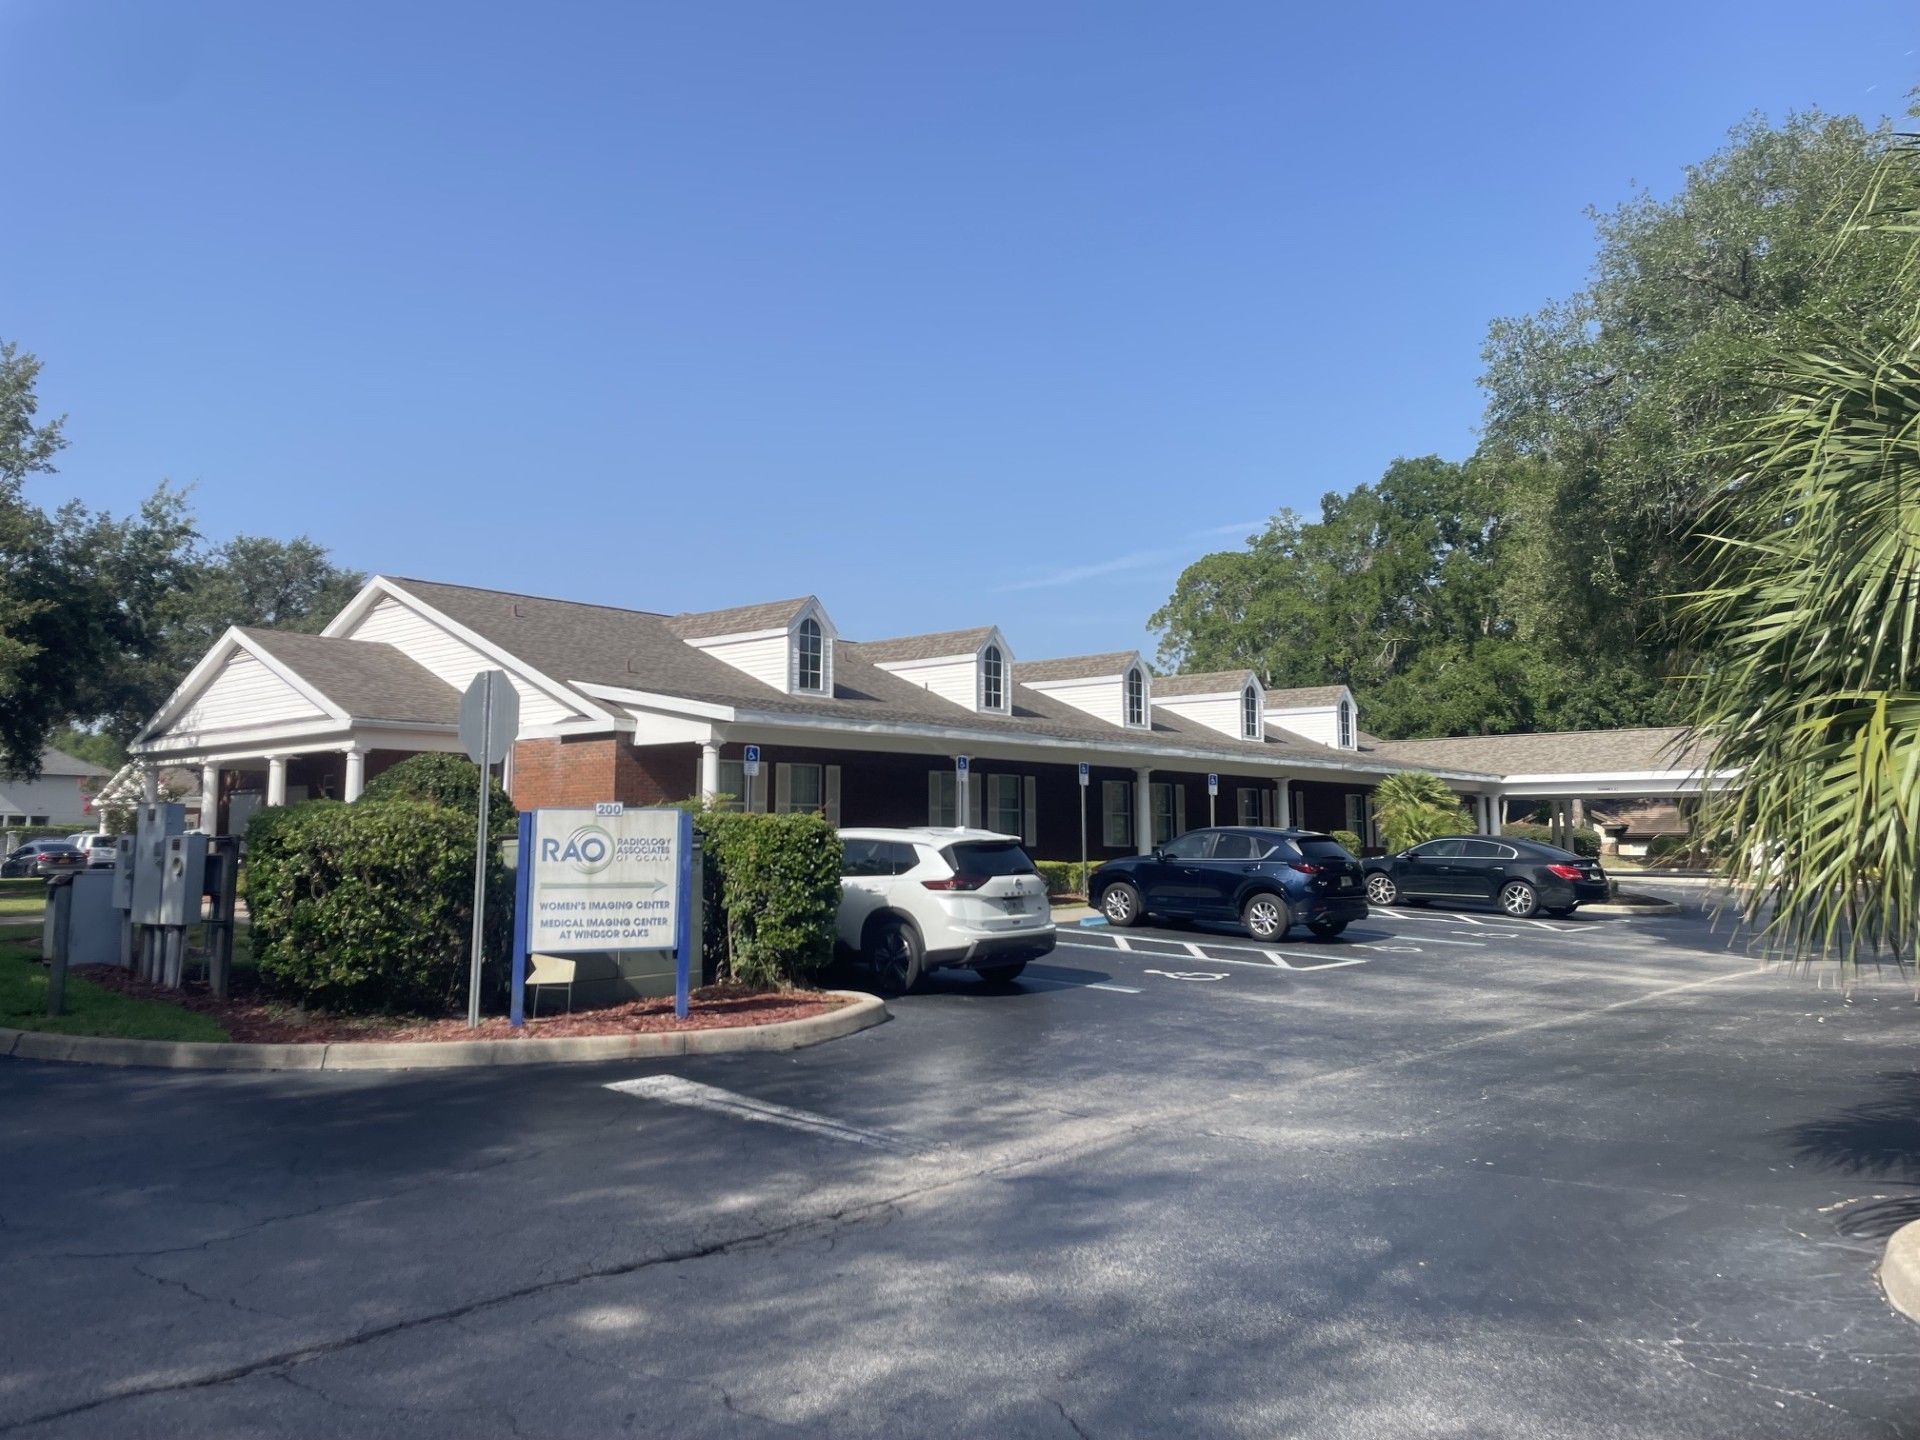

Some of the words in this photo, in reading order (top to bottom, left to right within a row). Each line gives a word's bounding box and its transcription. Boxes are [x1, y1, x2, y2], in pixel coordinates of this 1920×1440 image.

[598, 804, 621, 815] 200
[616, 838, 672, 846] RADIOLOGY
[541, 838, 606, 862] RAO
[616, 846, 671, 855] ASSOCIATES
[540, 902, 587, 911] WOMEN'S
[588, 901, 634, 910] IMAGING
[636, 900, 670, 910] CENTER
[540, 919, 584, 928] MEDICAL
[586, 918, 631, 927] IMAGING
[633, 917, 668, 926] CENTER
[560, 930, 572, 939] AT
[574, 929, 620, 939] WINDSOR
[622, 928, 649, 938] OAKS
